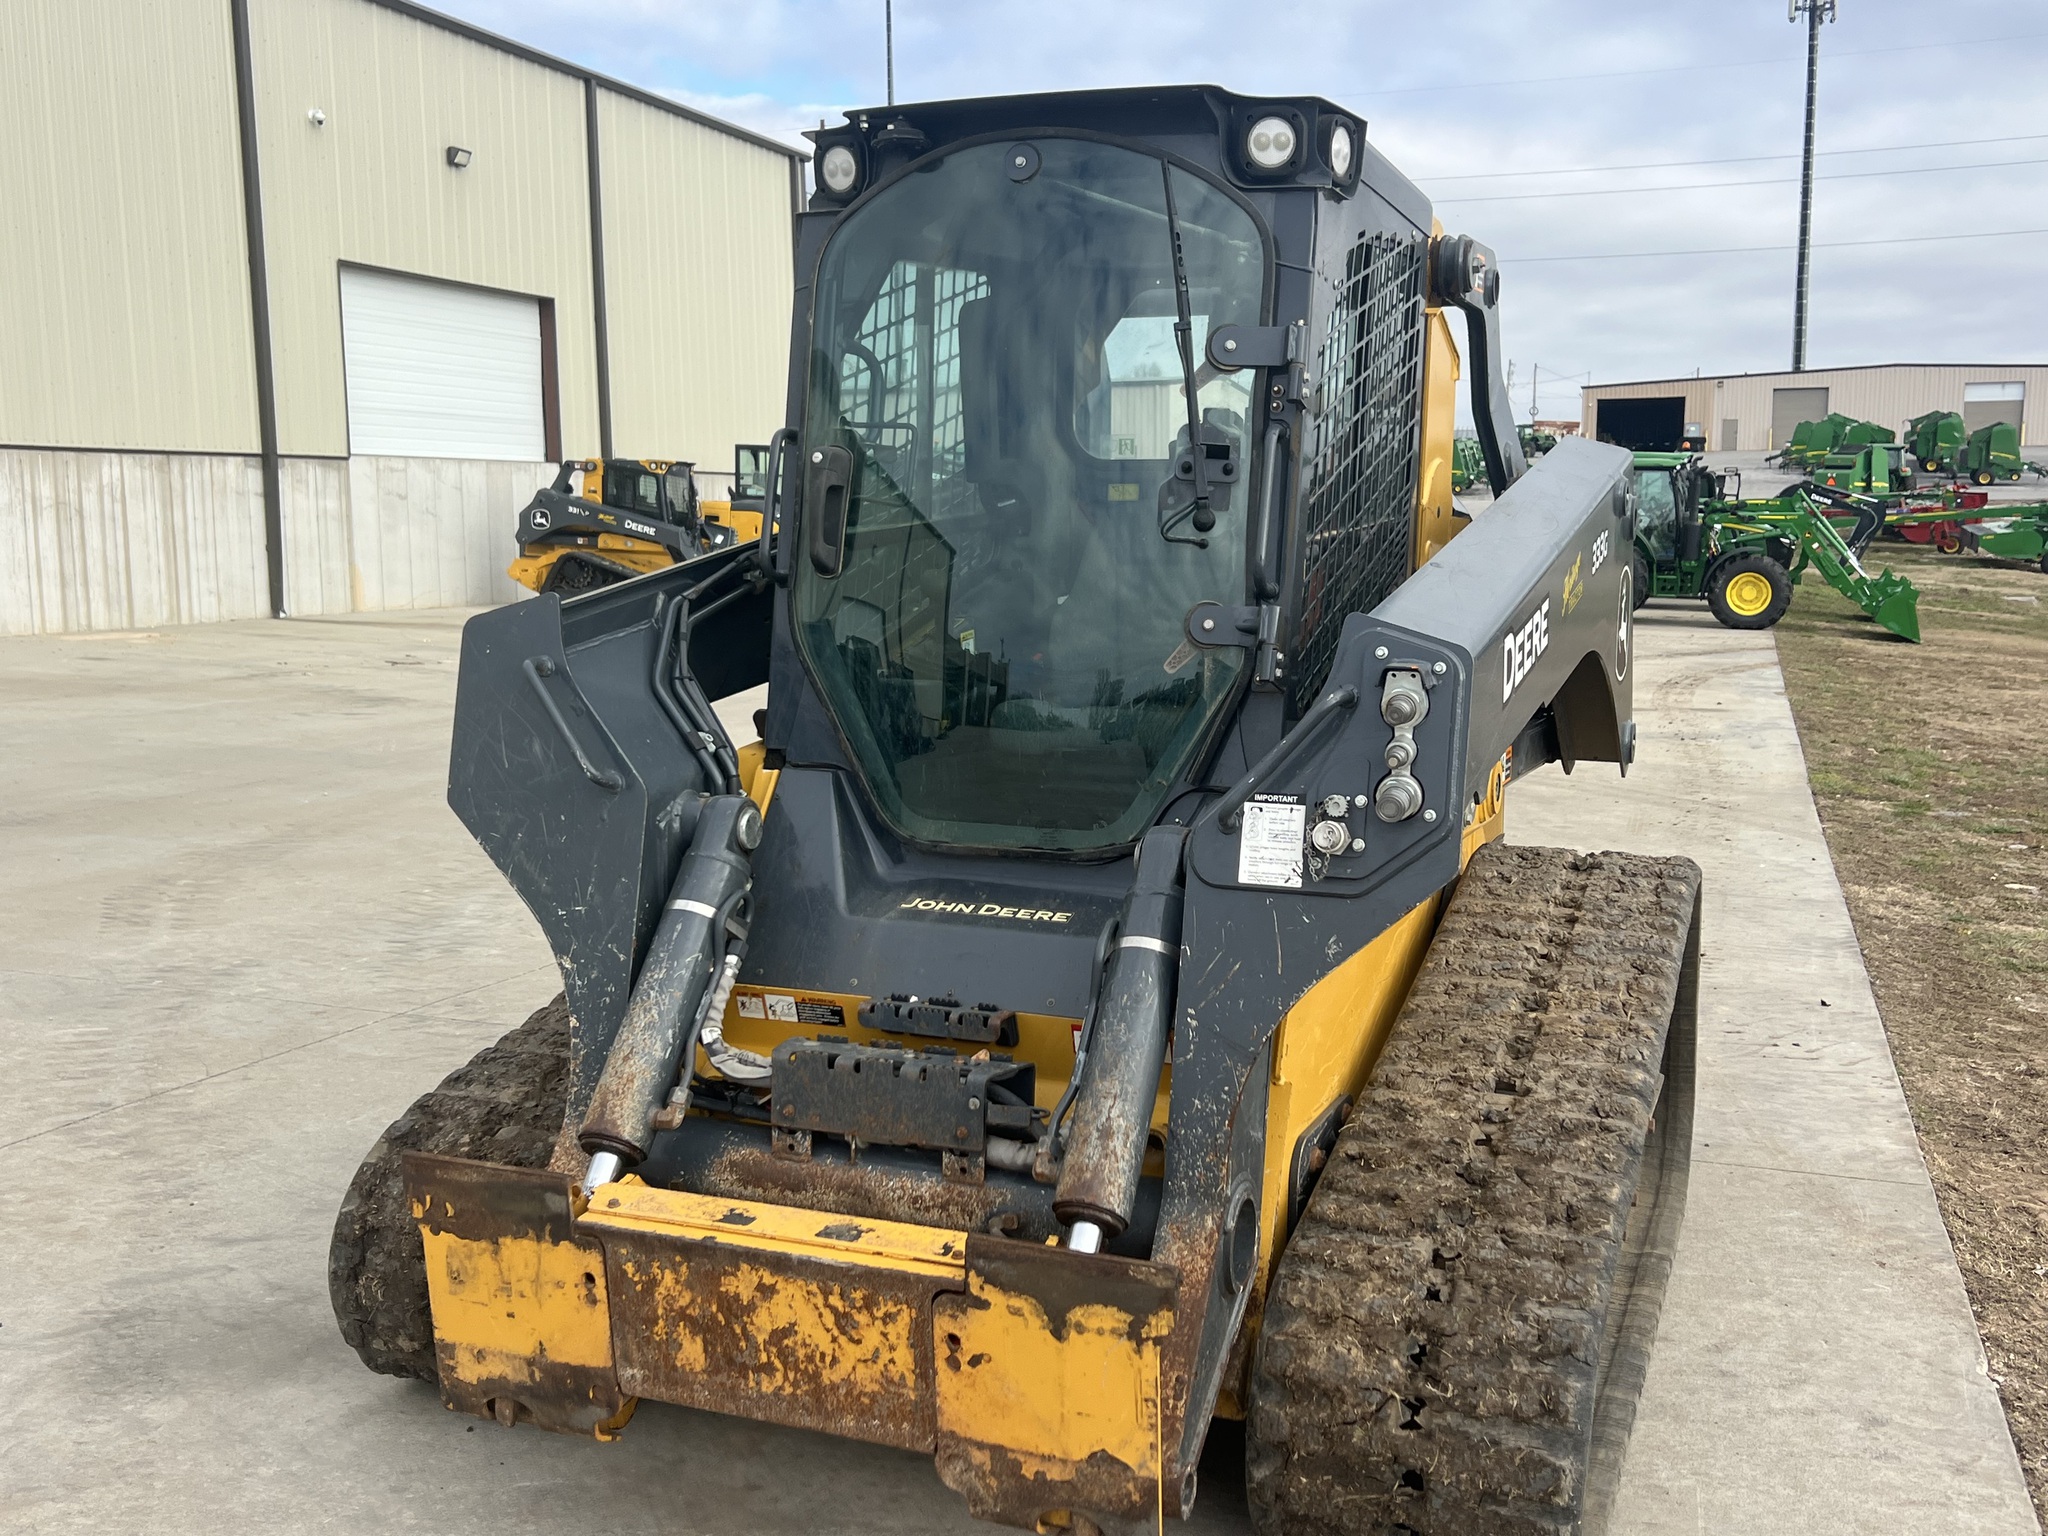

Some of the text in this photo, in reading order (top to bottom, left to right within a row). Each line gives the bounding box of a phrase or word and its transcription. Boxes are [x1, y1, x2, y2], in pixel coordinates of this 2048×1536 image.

[1810, 492, 1833, 505] DEERE
[624, 519, 656, 536] DEERE
[1503, 598, 1550, 704] DEERE
[1254, 794, 1298, 803] IMPORTANT
[900, 898, 1073, 922] JOHN DEERE
